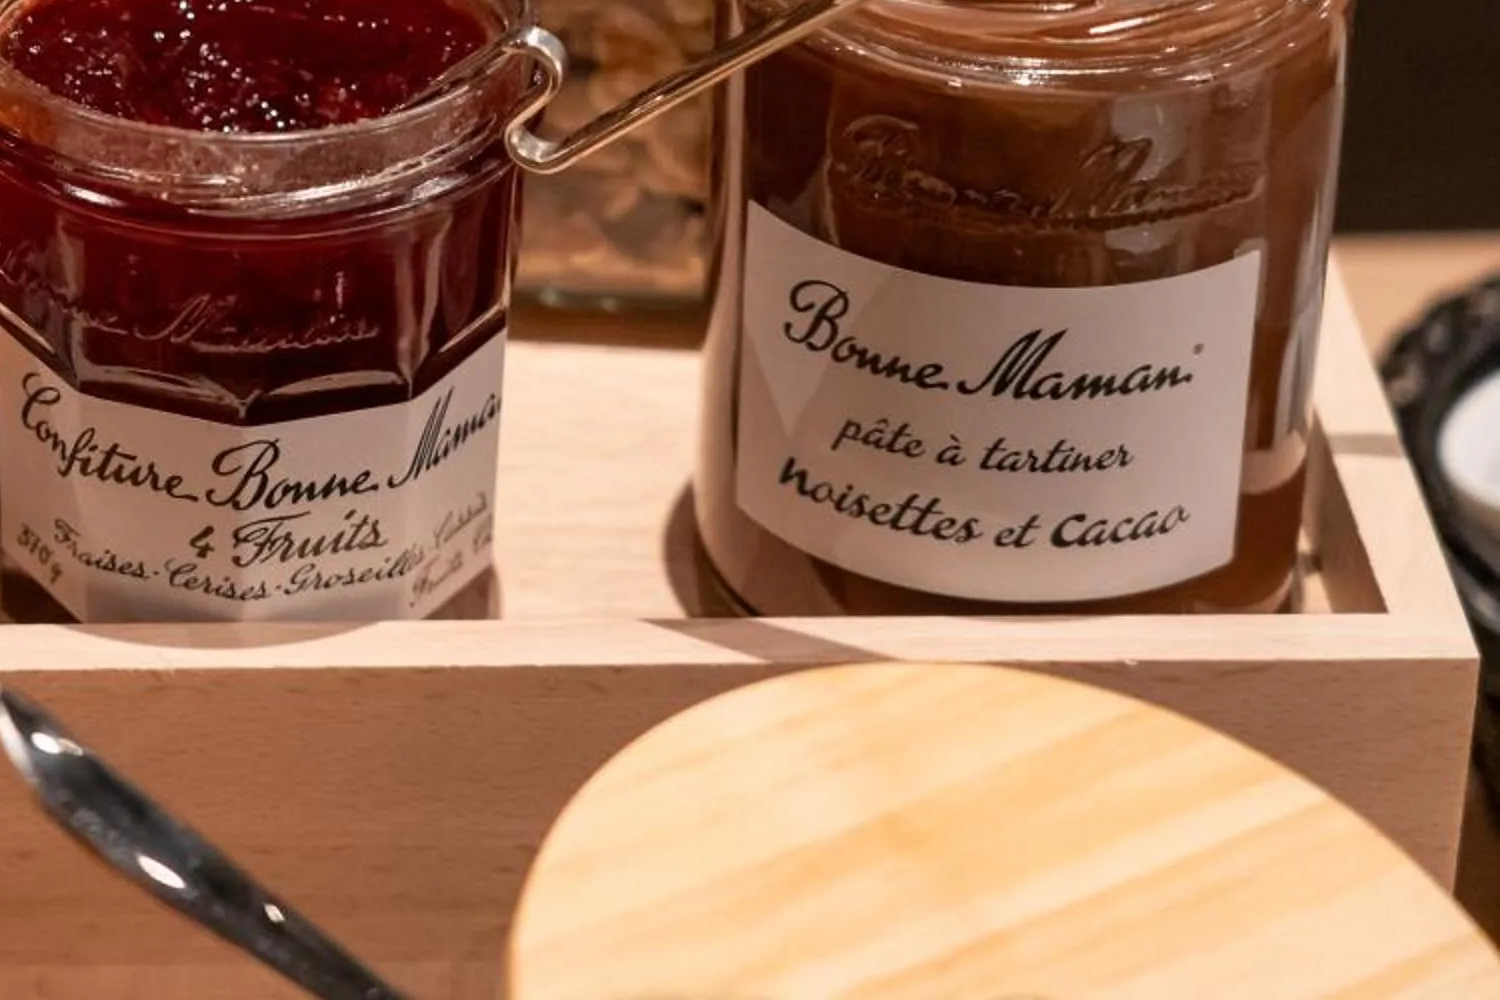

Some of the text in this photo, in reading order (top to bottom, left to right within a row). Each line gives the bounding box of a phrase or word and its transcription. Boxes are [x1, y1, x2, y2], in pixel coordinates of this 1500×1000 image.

[783, 279, 1193, 402] Bonne Maman
[21, 372, 199, 502] Confiture
[205, 438, 379, 511] Bonne
[830, 417, 1135, 474] pâte à tartiner
[53, 517, 151, 580] Fraises
[163, 558, 274, 602] Cerises
[189, 508, 388, 567] 4 Fruits
[993, 513, 1042, 549] et
